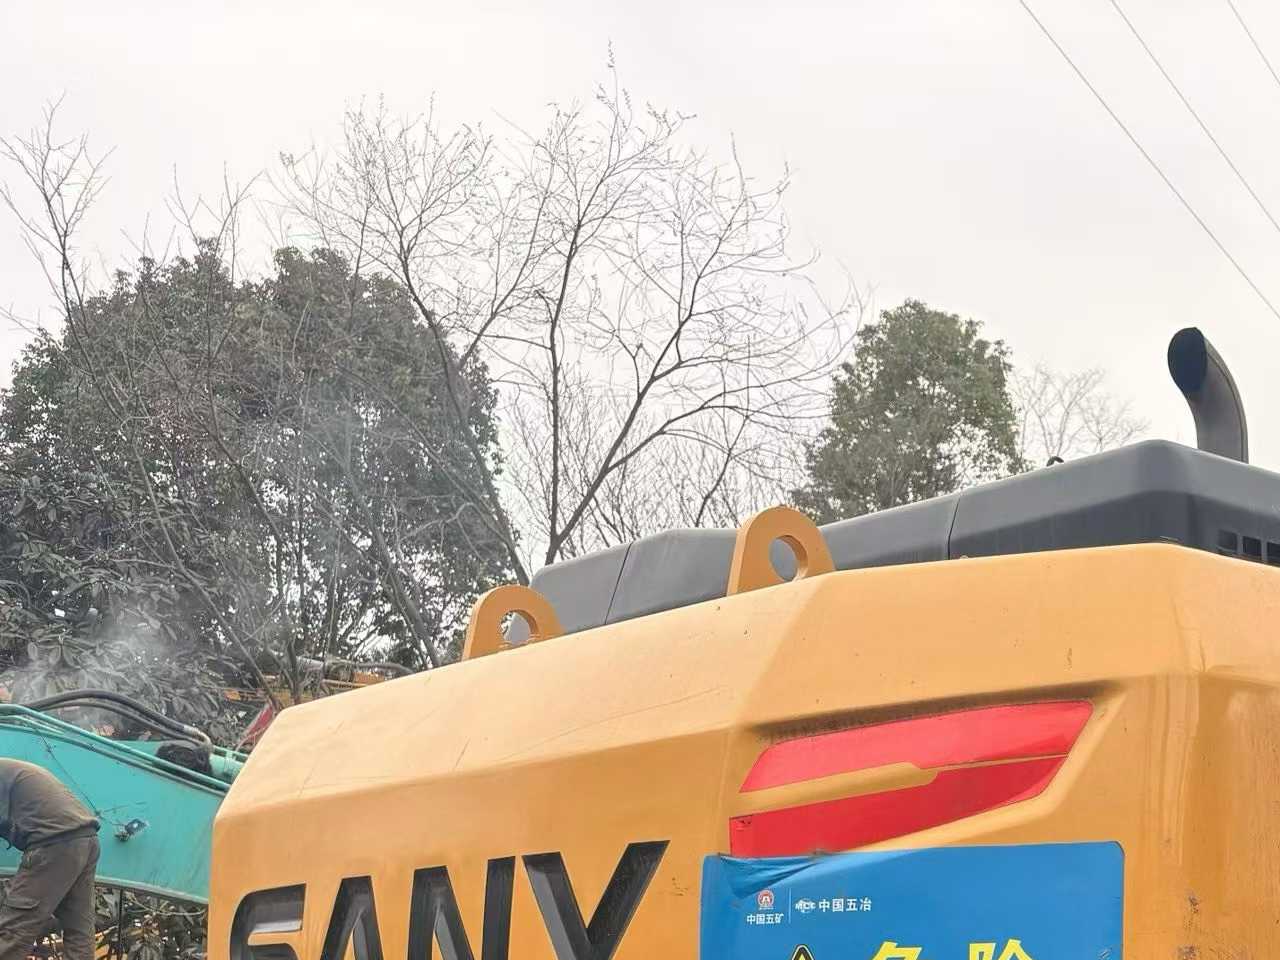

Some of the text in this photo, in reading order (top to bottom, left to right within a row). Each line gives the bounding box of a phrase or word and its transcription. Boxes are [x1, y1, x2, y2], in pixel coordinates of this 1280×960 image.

[819, 897, 872, 913] 中国五冶
[747, 913, 784, 925] 中国五矿
